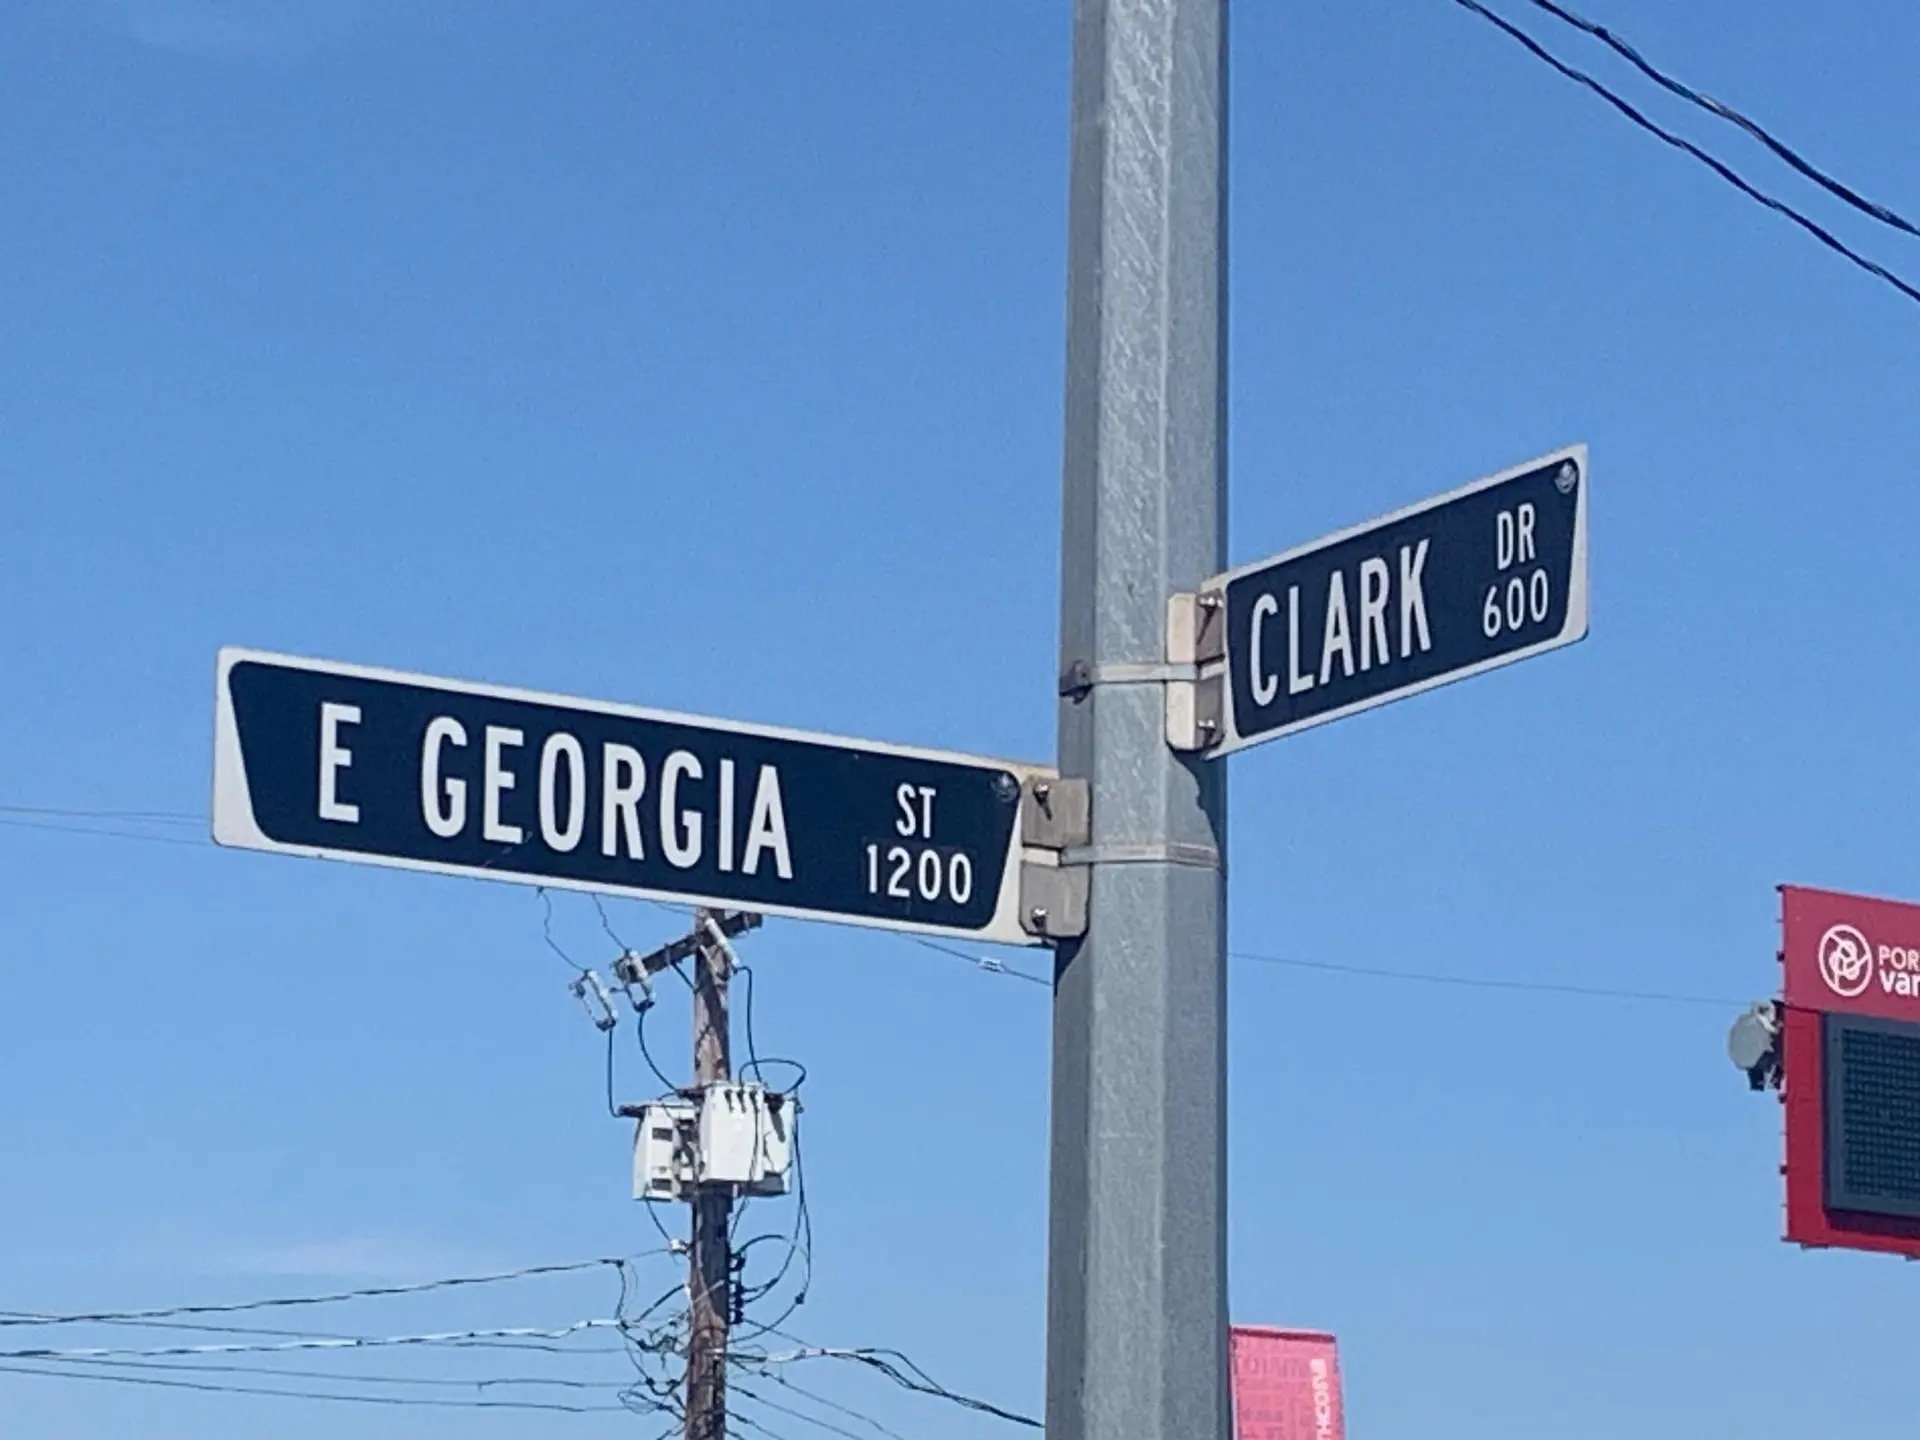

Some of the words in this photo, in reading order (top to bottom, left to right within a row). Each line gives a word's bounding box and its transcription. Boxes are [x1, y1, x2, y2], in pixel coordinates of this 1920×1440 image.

[1251, 539, 1431, 706] CLARK
[1497, 503, 1535, 570] DR
[1484, 569, 1549, 637] 600
[319, 702, 361, 823] E
[421, 716, 793, 879] GEORGIA
[896, 783, 937, 838] ST
[867, 844, 973, 905] 1200
